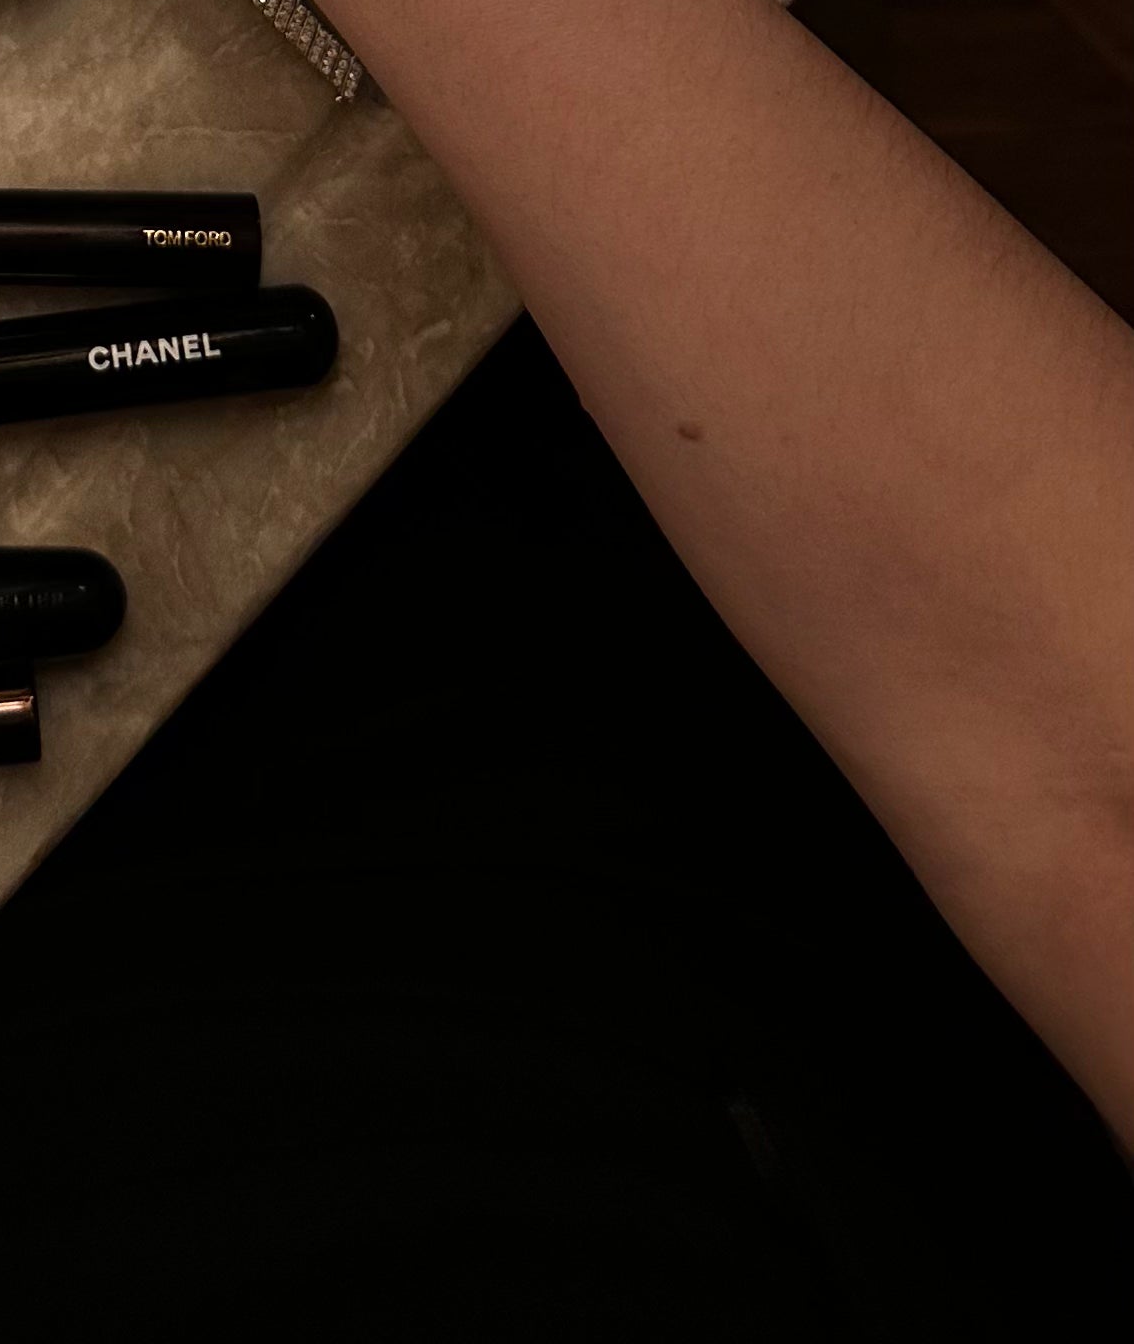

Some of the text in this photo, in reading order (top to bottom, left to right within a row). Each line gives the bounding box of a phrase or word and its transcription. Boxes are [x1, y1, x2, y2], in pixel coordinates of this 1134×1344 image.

[142, 229, 232, 248] TOM FORD
[88, 332, 222, 372] CHANEL
